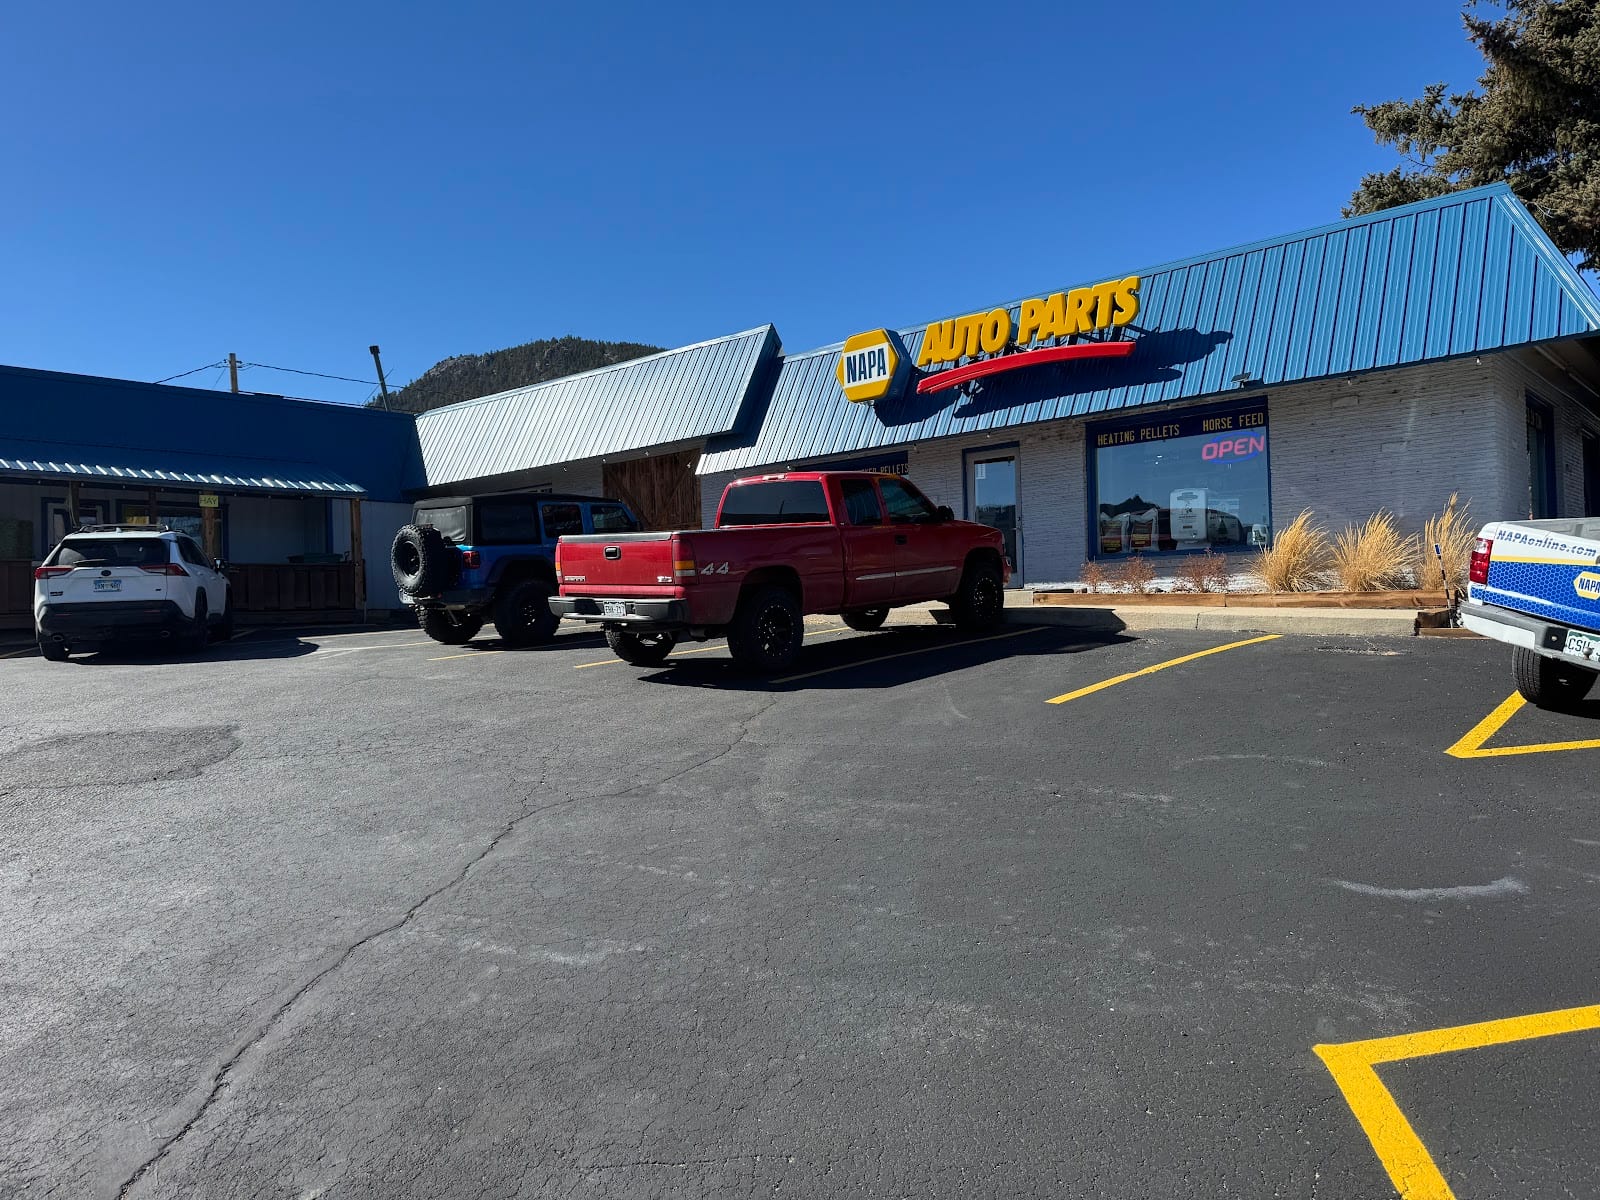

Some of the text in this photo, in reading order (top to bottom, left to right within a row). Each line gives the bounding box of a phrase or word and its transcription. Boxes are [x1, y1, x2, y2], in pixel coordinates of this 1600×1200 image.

[917, 276, 1140, 366] AUTO PARTS
[846, 348, 887, 383] NAPA
[1202, 412, 1264, 432] HORSE FEED
[1097, 424, 1180, 446] HEATING PELLETS
[1201, 436, 1265, 461] OPEN
[880, 463, 909, 474] PELLETS
[1496, 529, 1597, 557] NAPAonline.com
